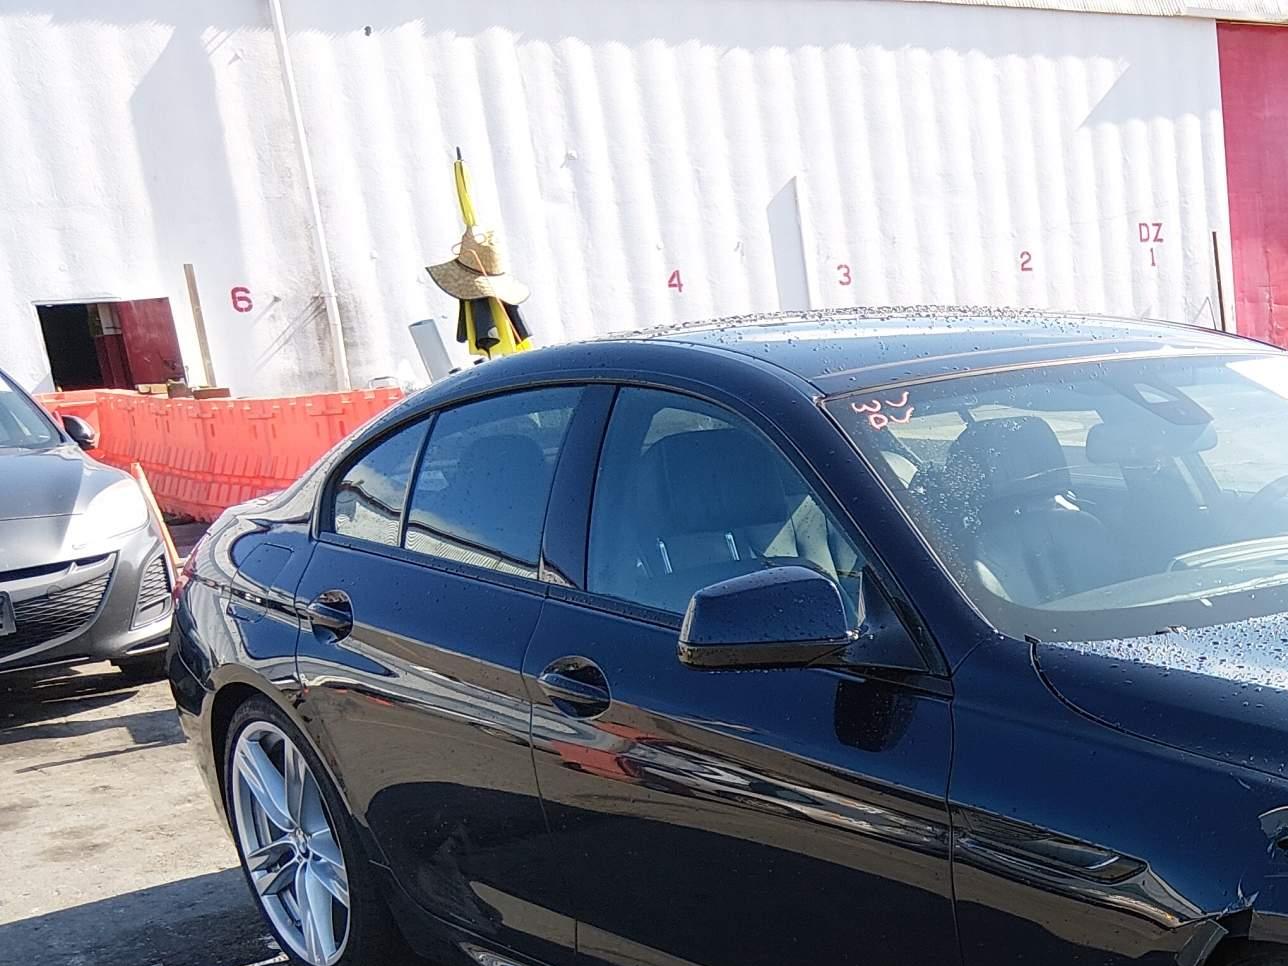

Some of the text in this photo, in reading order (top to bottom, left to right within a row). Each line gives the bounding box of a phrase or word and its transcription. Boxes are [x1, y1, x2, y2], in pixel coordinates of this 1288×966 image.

[1138, 222, 1164, 243] DZ
[1020, 250, 1033, 272] 2
[667, 269, 684, 293] 4
[837, 264, 851, 286] 3
[230, 286, 253, 313] 6
